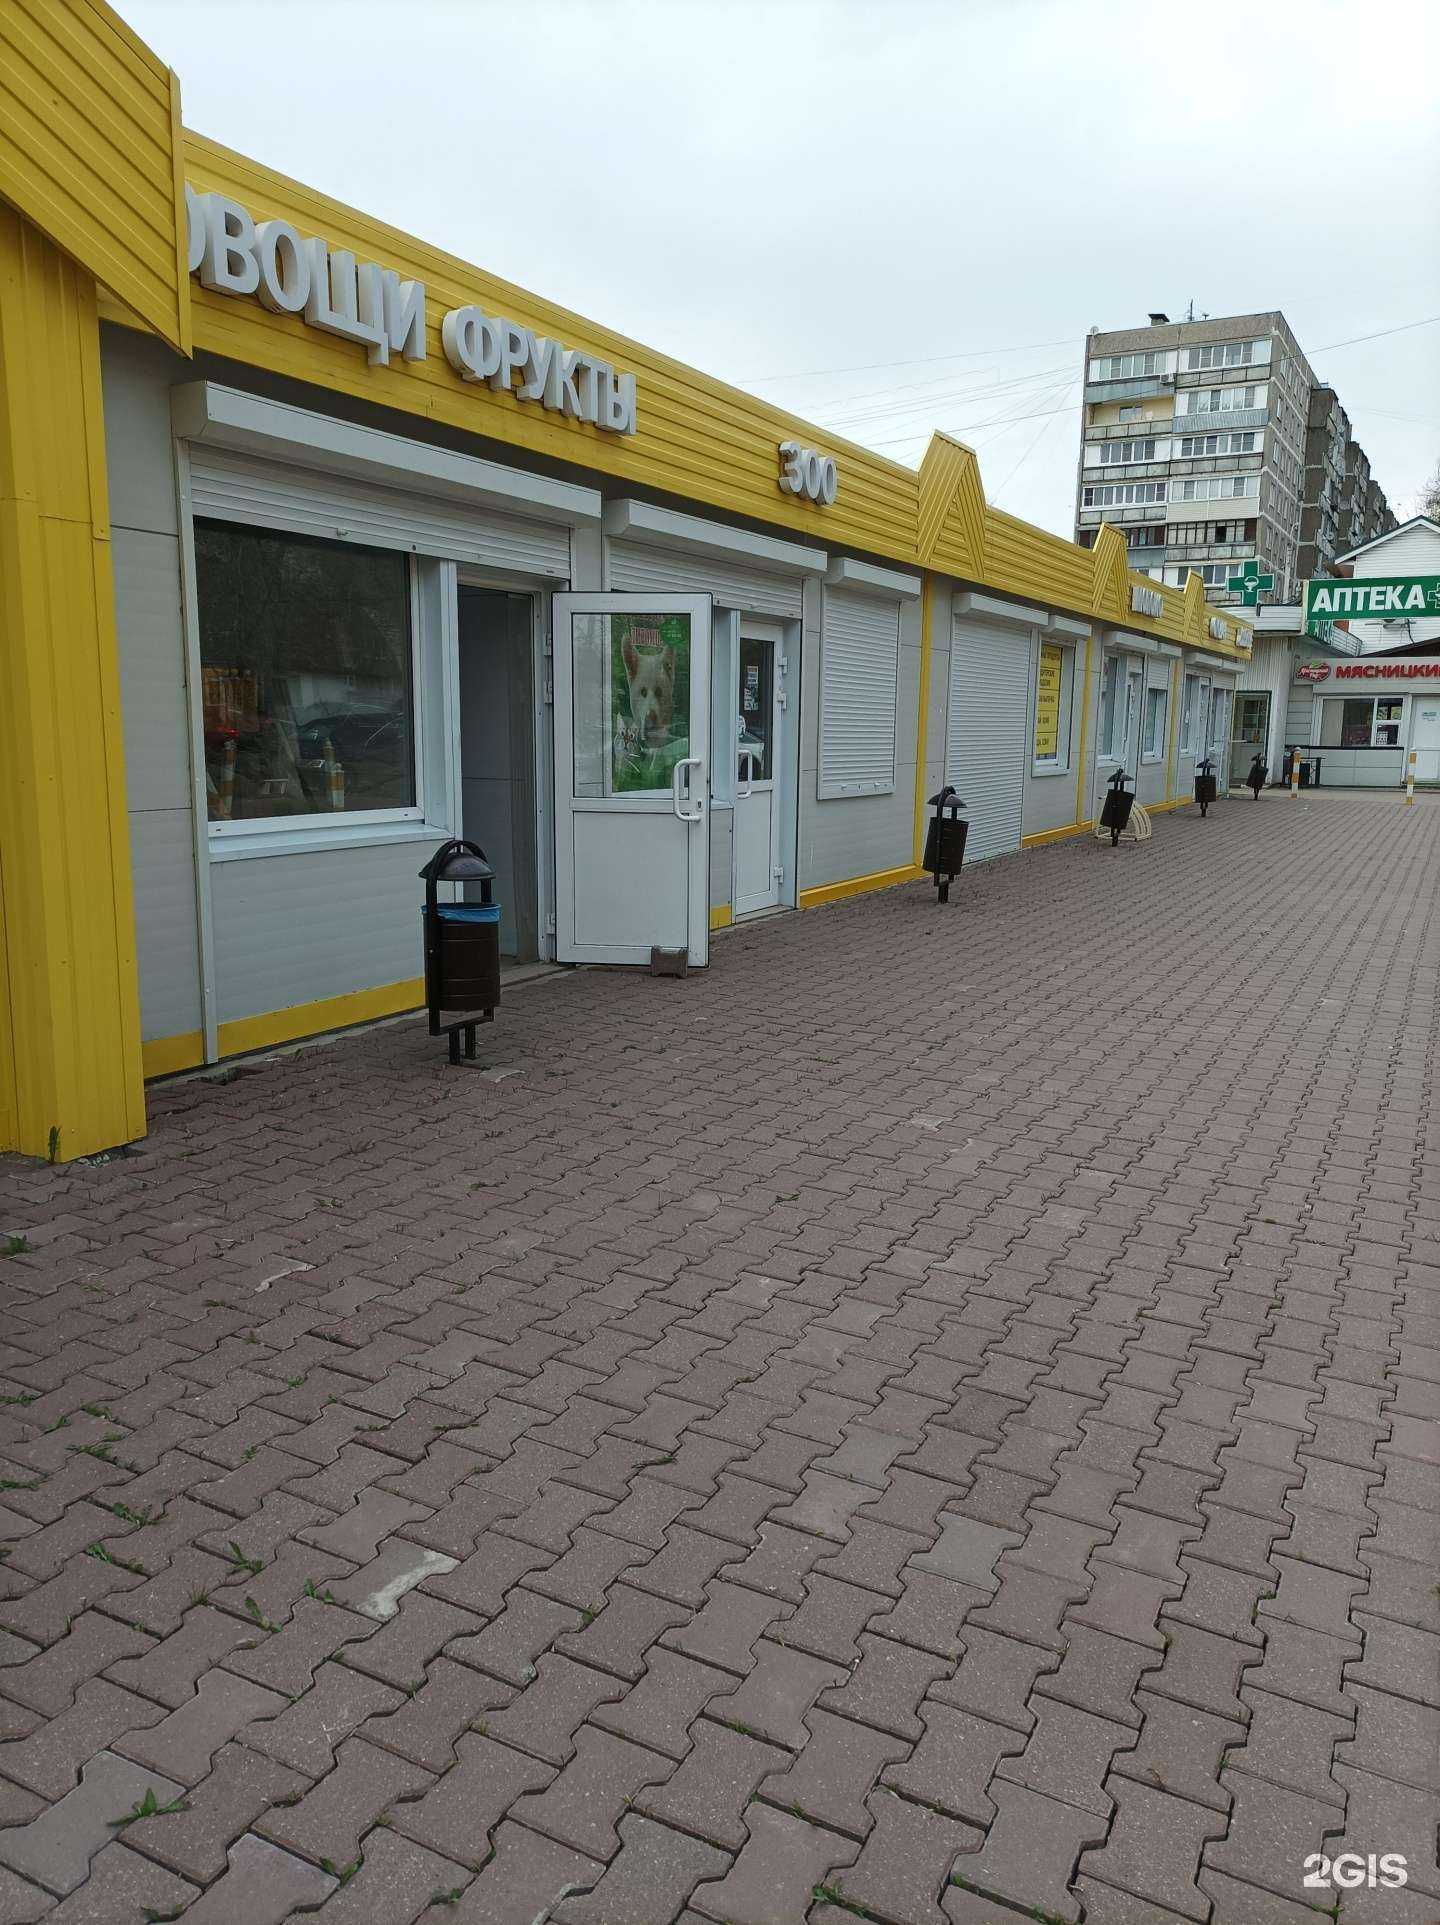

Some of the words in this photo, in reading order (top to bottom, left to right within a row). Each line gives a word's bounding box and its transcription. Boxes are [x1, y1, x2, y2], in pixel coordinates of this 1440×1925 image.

[442, 304, 637, 435] ФРУКТЫ
[1311, 584, 1427, 613] АПТЕКА
[1335, 663, 1440, 679] МЯСНИЦКИ
